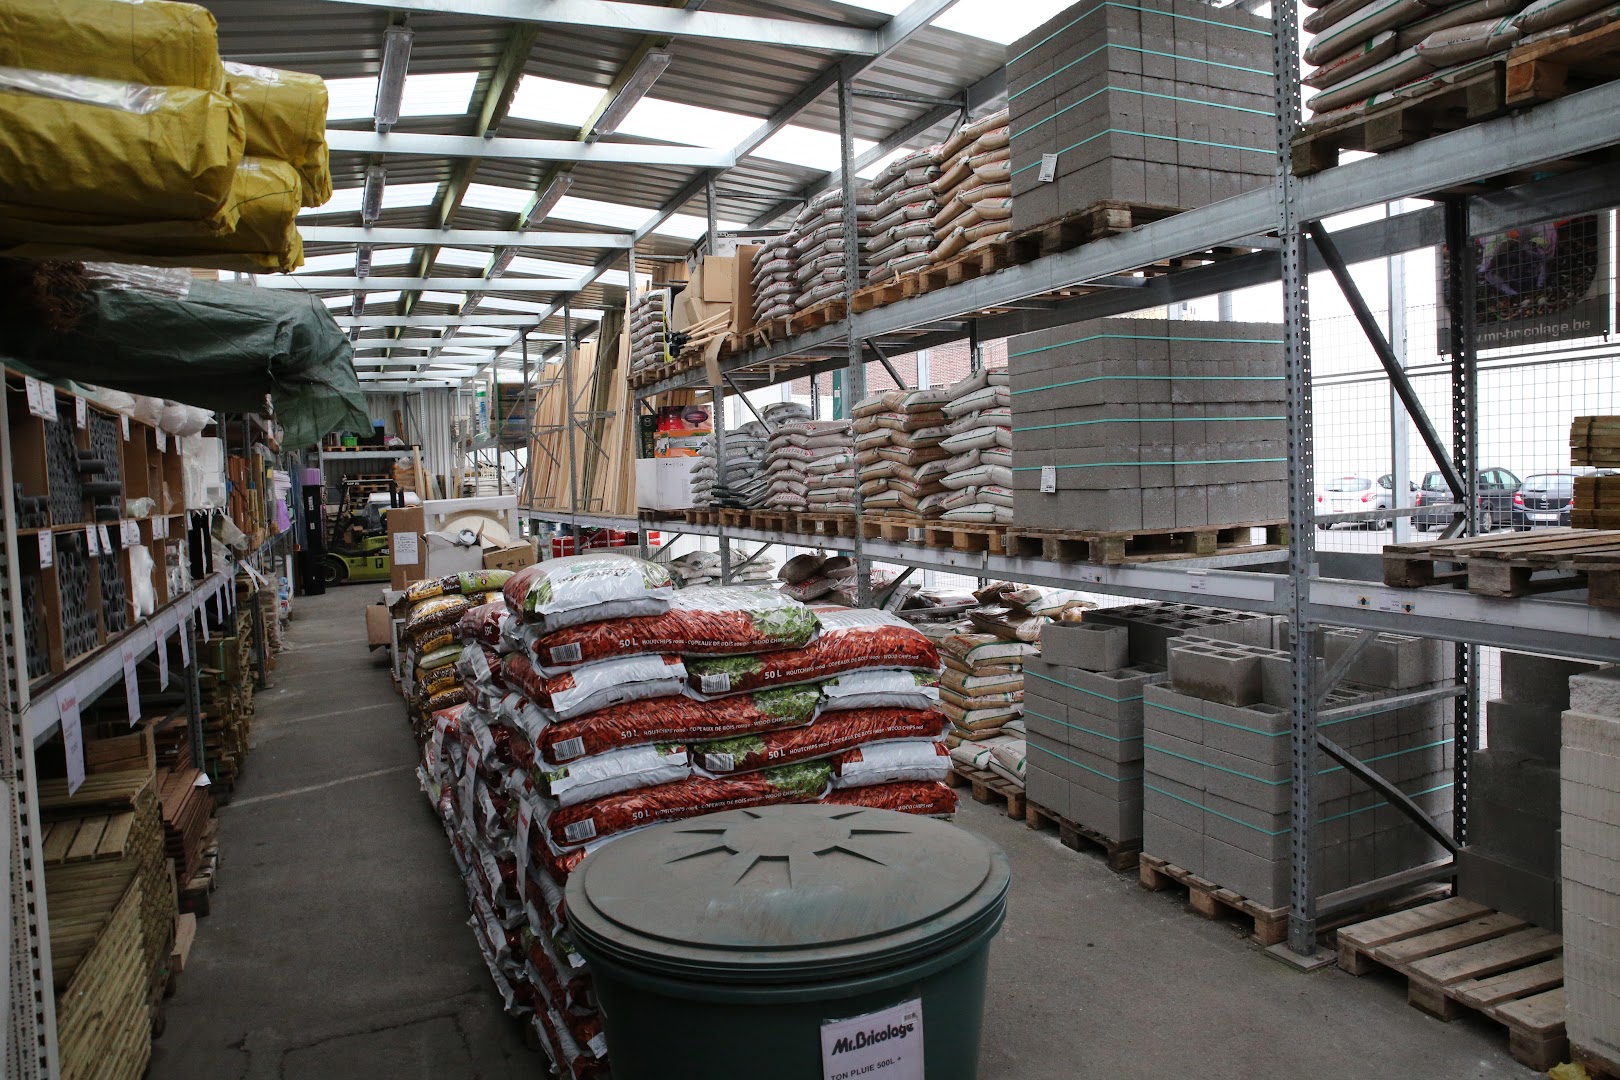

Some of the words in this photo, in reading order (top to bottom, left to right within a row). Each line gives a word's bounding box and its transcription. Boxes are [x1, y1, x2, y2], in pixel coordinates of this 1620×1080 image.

[1476, 319, 1590, 342] .mr-brcolage.be
[619, 640, 630, 648] 50
[764, 671, 775, 680] 50
[786, 667, 814, 676] HOUTCHIPS
[621, 731, 632, 740] 50
[768, 750, 779, 760] 50
[780, 748, 786, 756] L
[790, 744, 818, 754] HOUTCHIPS
[632, 811, 644, 820] 50
[831, 1023, 915, 1056] Mr.Bricolage
[850, 1064, 876, 1077] PLUIE
[876, 1058, 896, 1069] 500L
